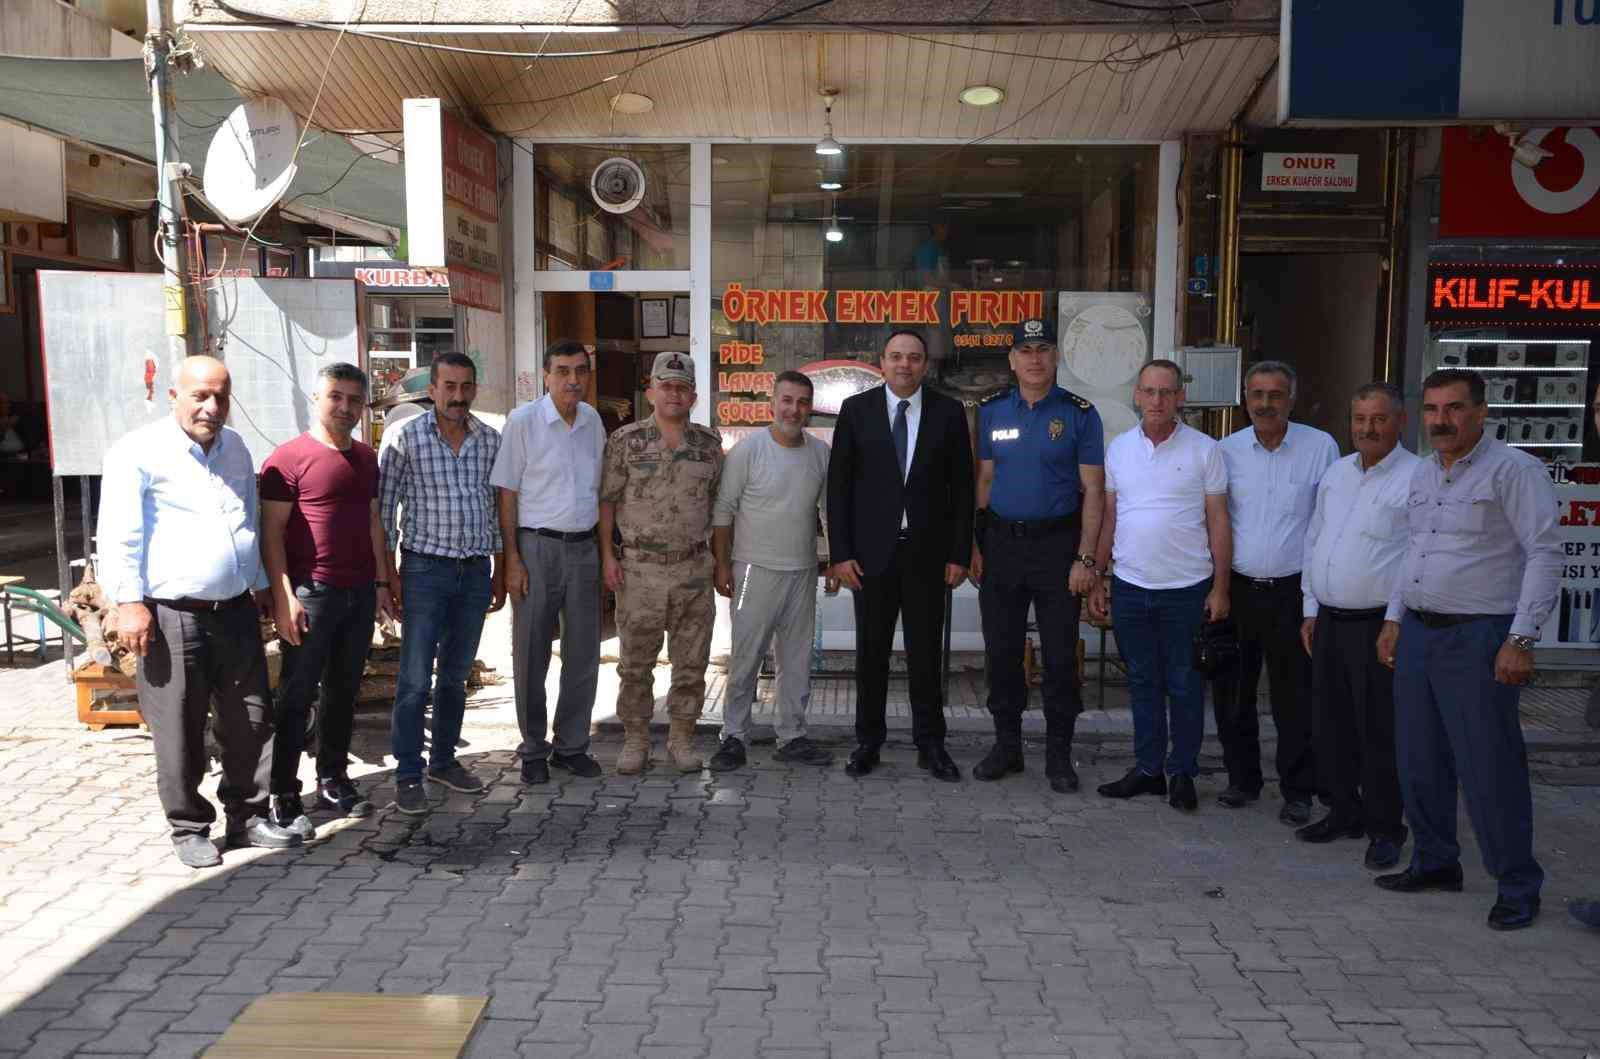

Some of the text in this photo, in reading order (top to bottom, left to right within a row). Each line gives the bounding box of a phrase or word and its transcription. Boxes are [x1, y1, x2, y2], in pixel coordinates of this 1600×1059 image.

[1283, 157, 1336, 169] ONUR
[1266, 175, 1293, 186] ERKEK
[1323, 175, 1353, 187] SALONU
[722, 283, 1043, 327] ÖRNEK EKMEK FIRINI
[1433, 278, 1600, 309] KILIF-KUL
[719, 340, 764, 365] PİDE
[718, 371, 776, 397] LAVAŞ
[1562, 542, 1586, 557] EP
